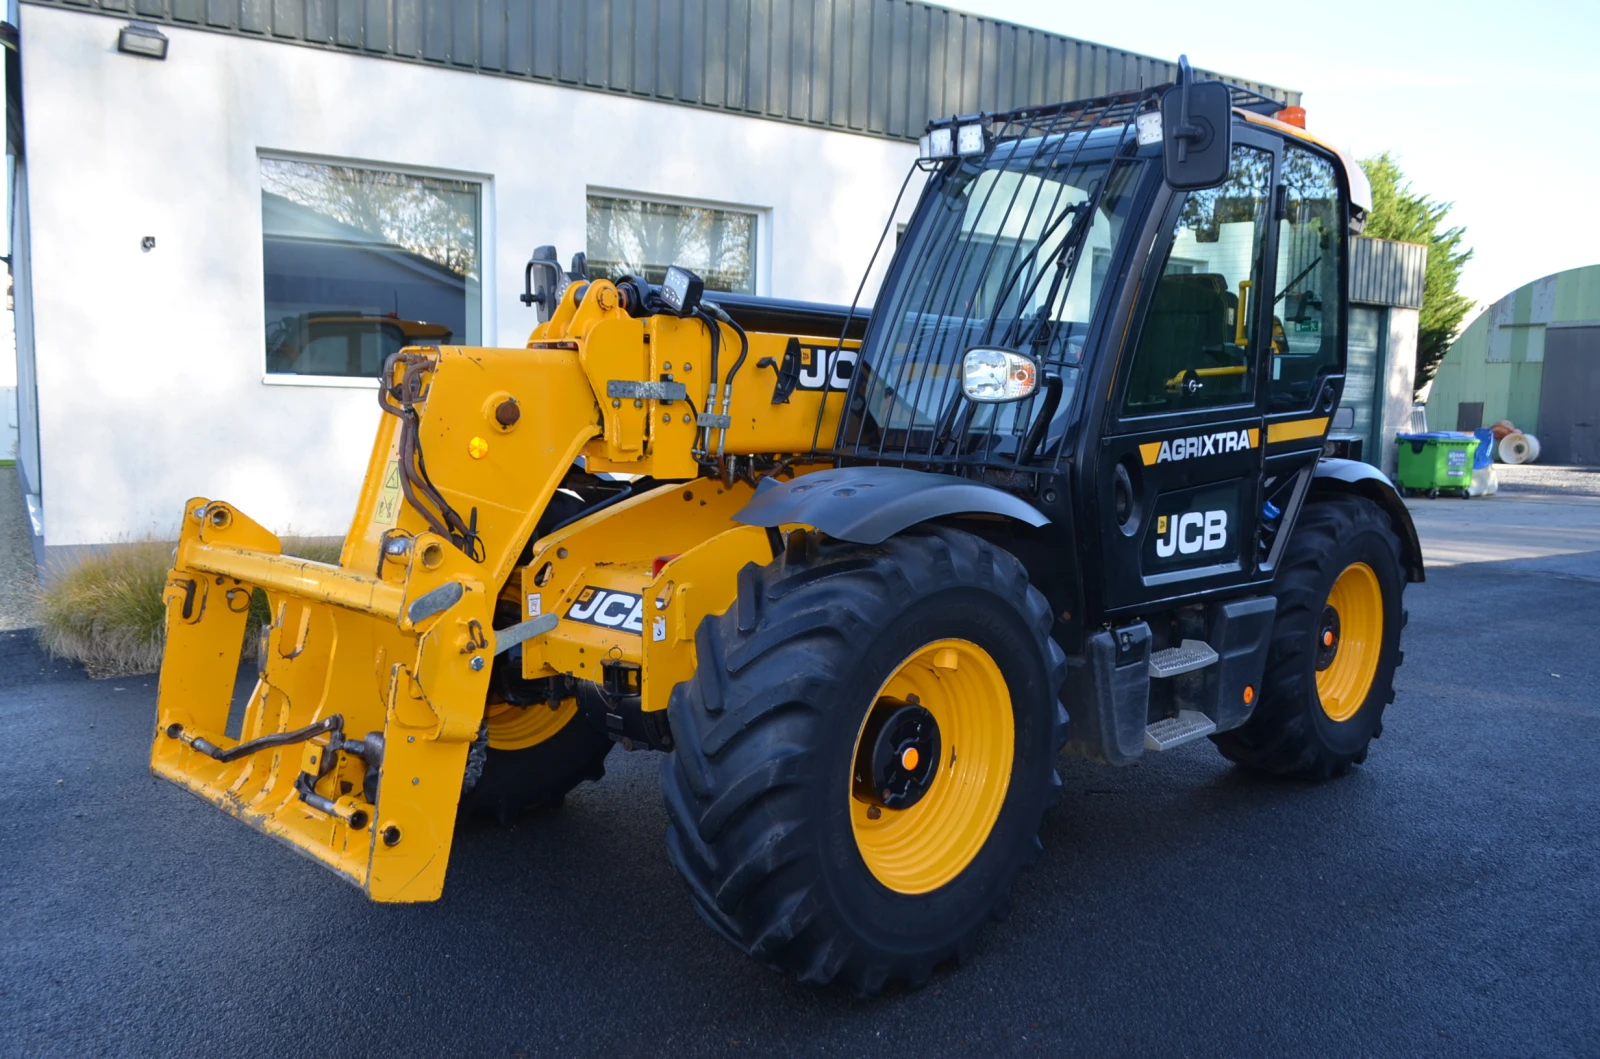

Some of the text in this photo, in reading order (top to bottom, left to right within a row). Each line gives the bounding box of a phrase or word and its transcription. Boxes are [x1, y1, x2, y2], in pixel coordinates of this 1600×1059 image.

[799, 349, 858, 389] JC
[1156, 429, 1251, 464] AGRIXTRA
[1156, 509, 1228, 558] JCB
